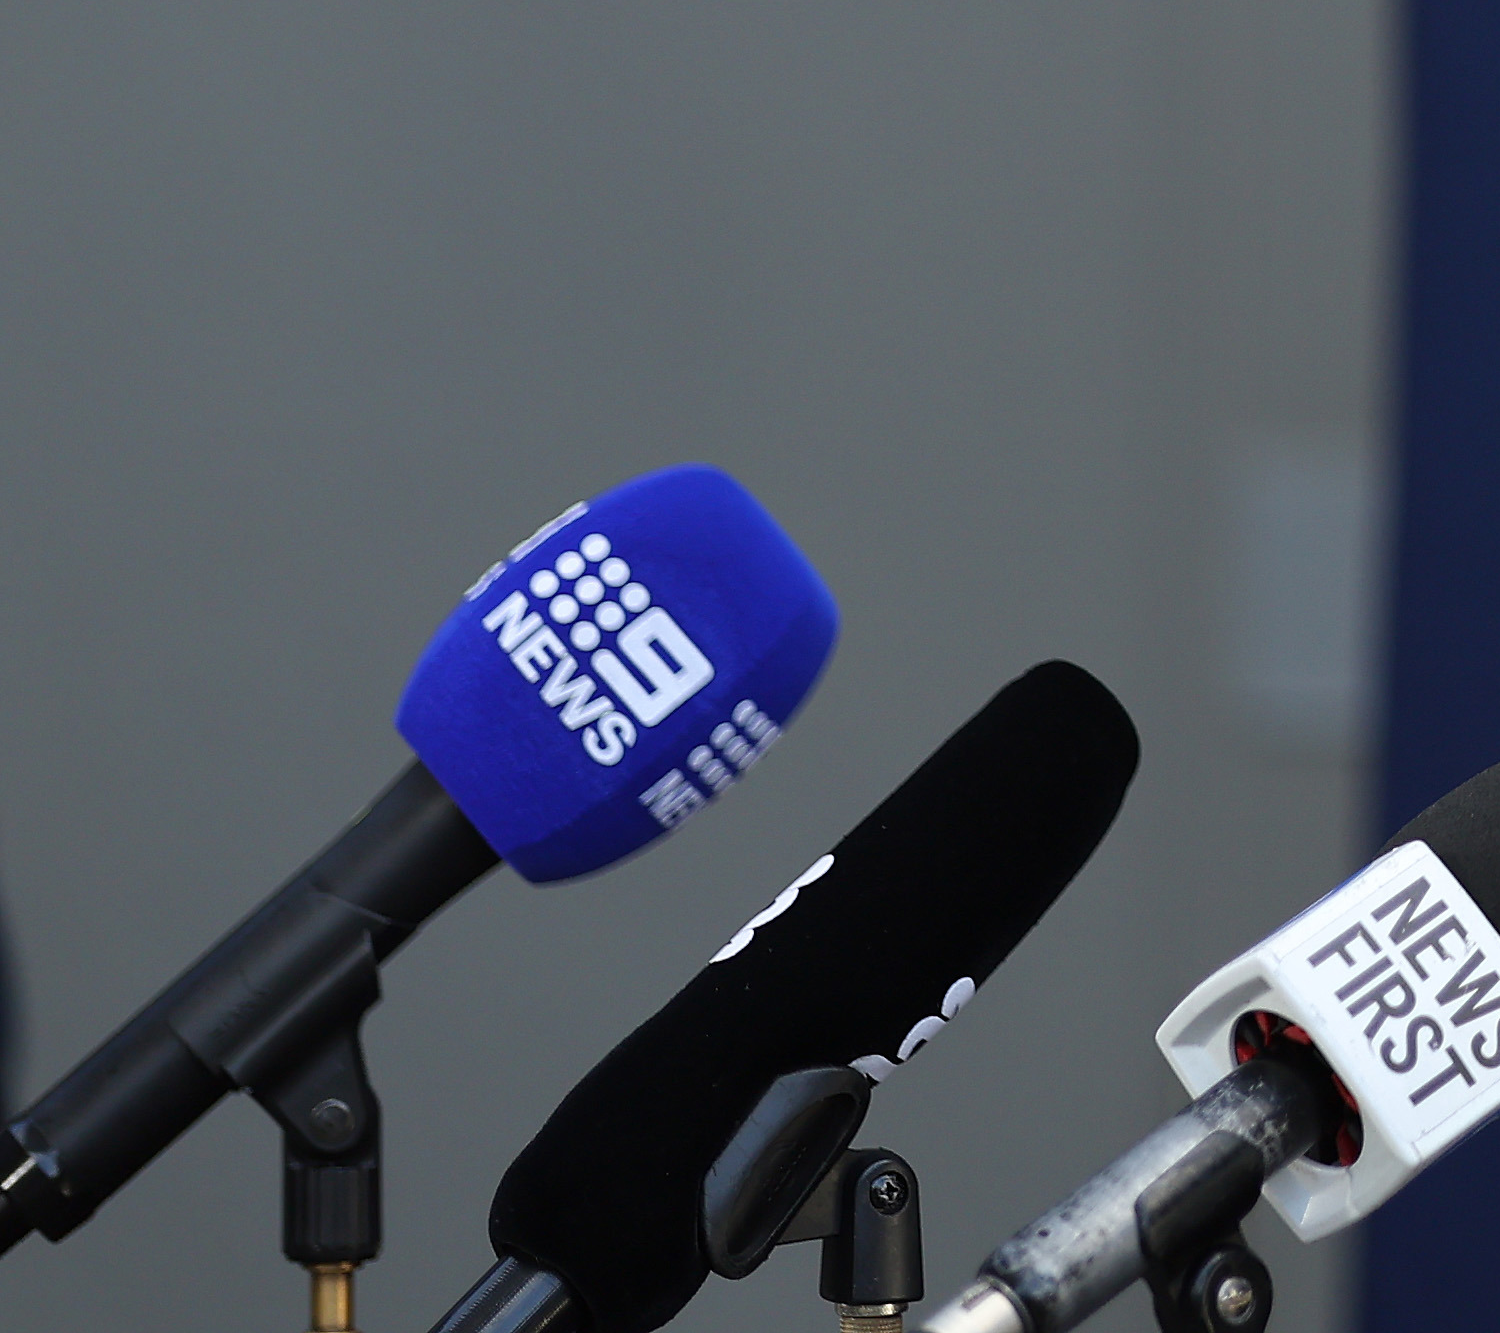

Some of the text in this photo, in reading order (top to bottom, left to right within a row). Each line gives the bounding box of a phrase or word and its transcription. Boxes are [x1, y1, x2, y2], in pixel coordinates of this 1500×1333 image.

[482, 590, 638, 767] NEWS
[590, 606, 716, 728] 9
[1306, 921, 1476, 1108] FIRST
